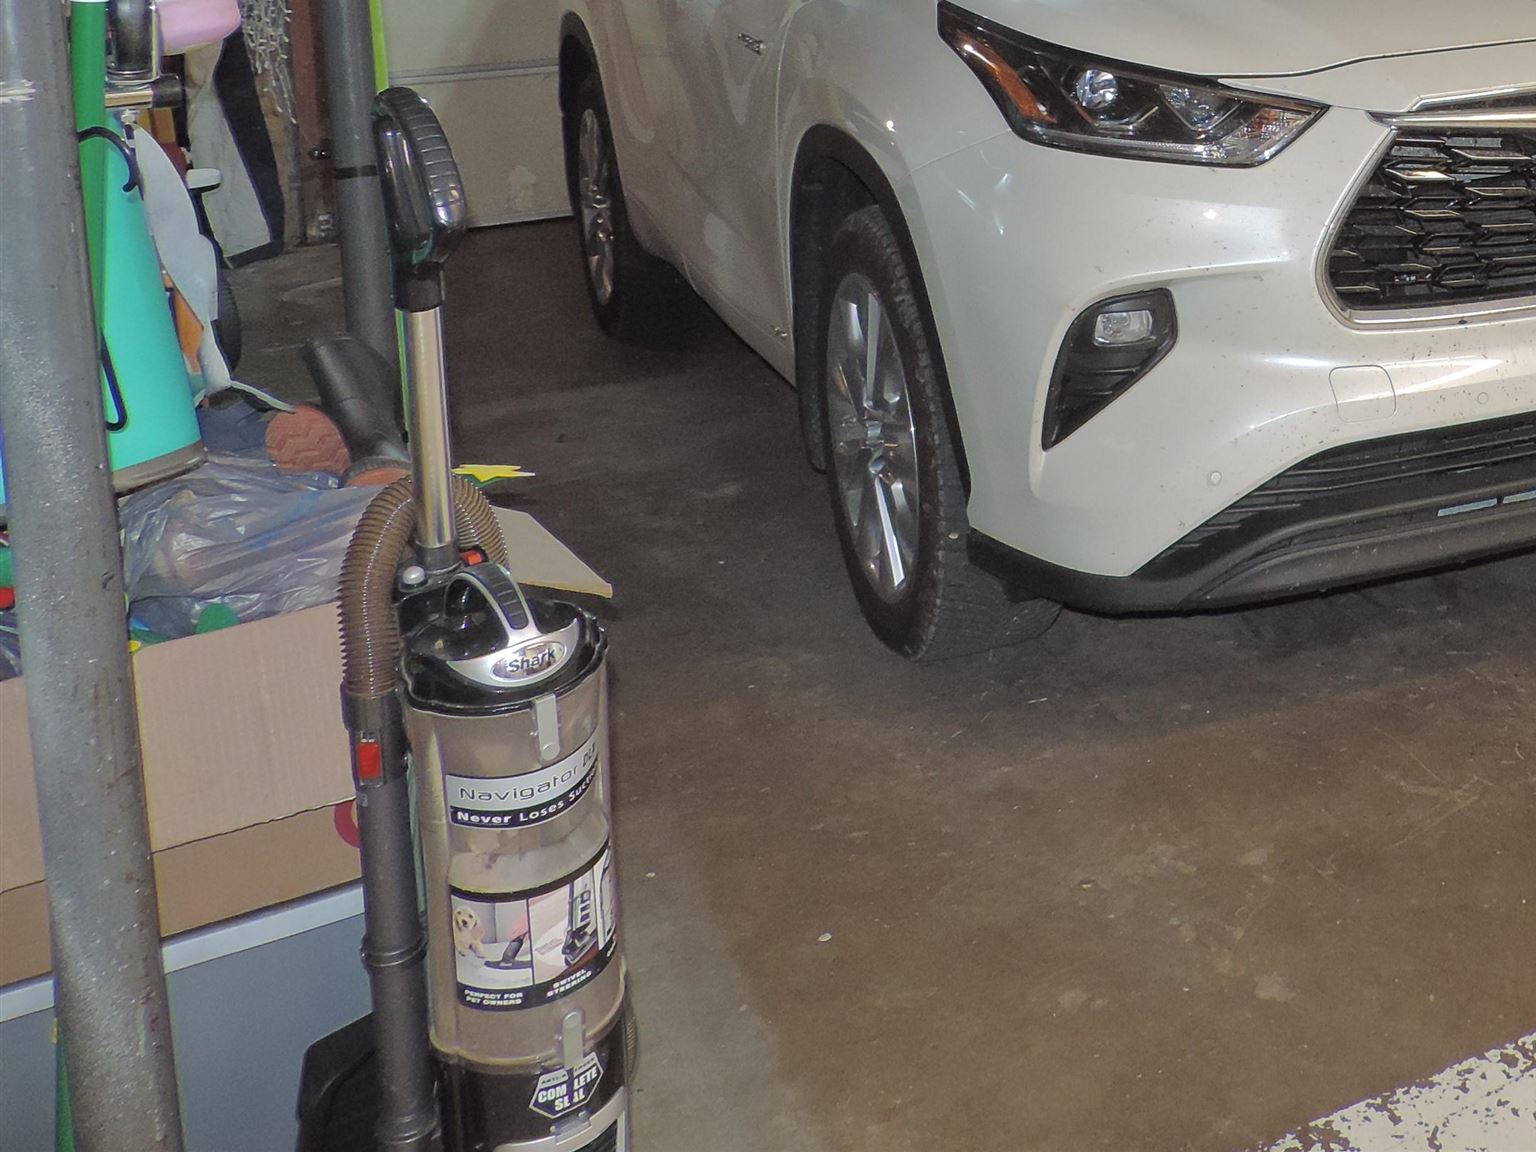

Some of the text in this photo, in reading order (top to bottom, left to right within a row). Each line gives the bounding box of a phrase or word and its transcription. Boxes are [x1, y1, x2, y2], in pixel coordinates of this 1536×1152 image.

[508, 648, 556, 673] Shark
[460, 764, 578, 801] Navigator
[457, 811, 512, 825] Never
[519, 800, 565, 822] Loses
[546, 971, 593, 997] STEERING
[553, 968, 587, 988] SWIVEL
[465, 997, 523, 1006] PET OWNERS
[503, 991, 524, 1000] FOR
